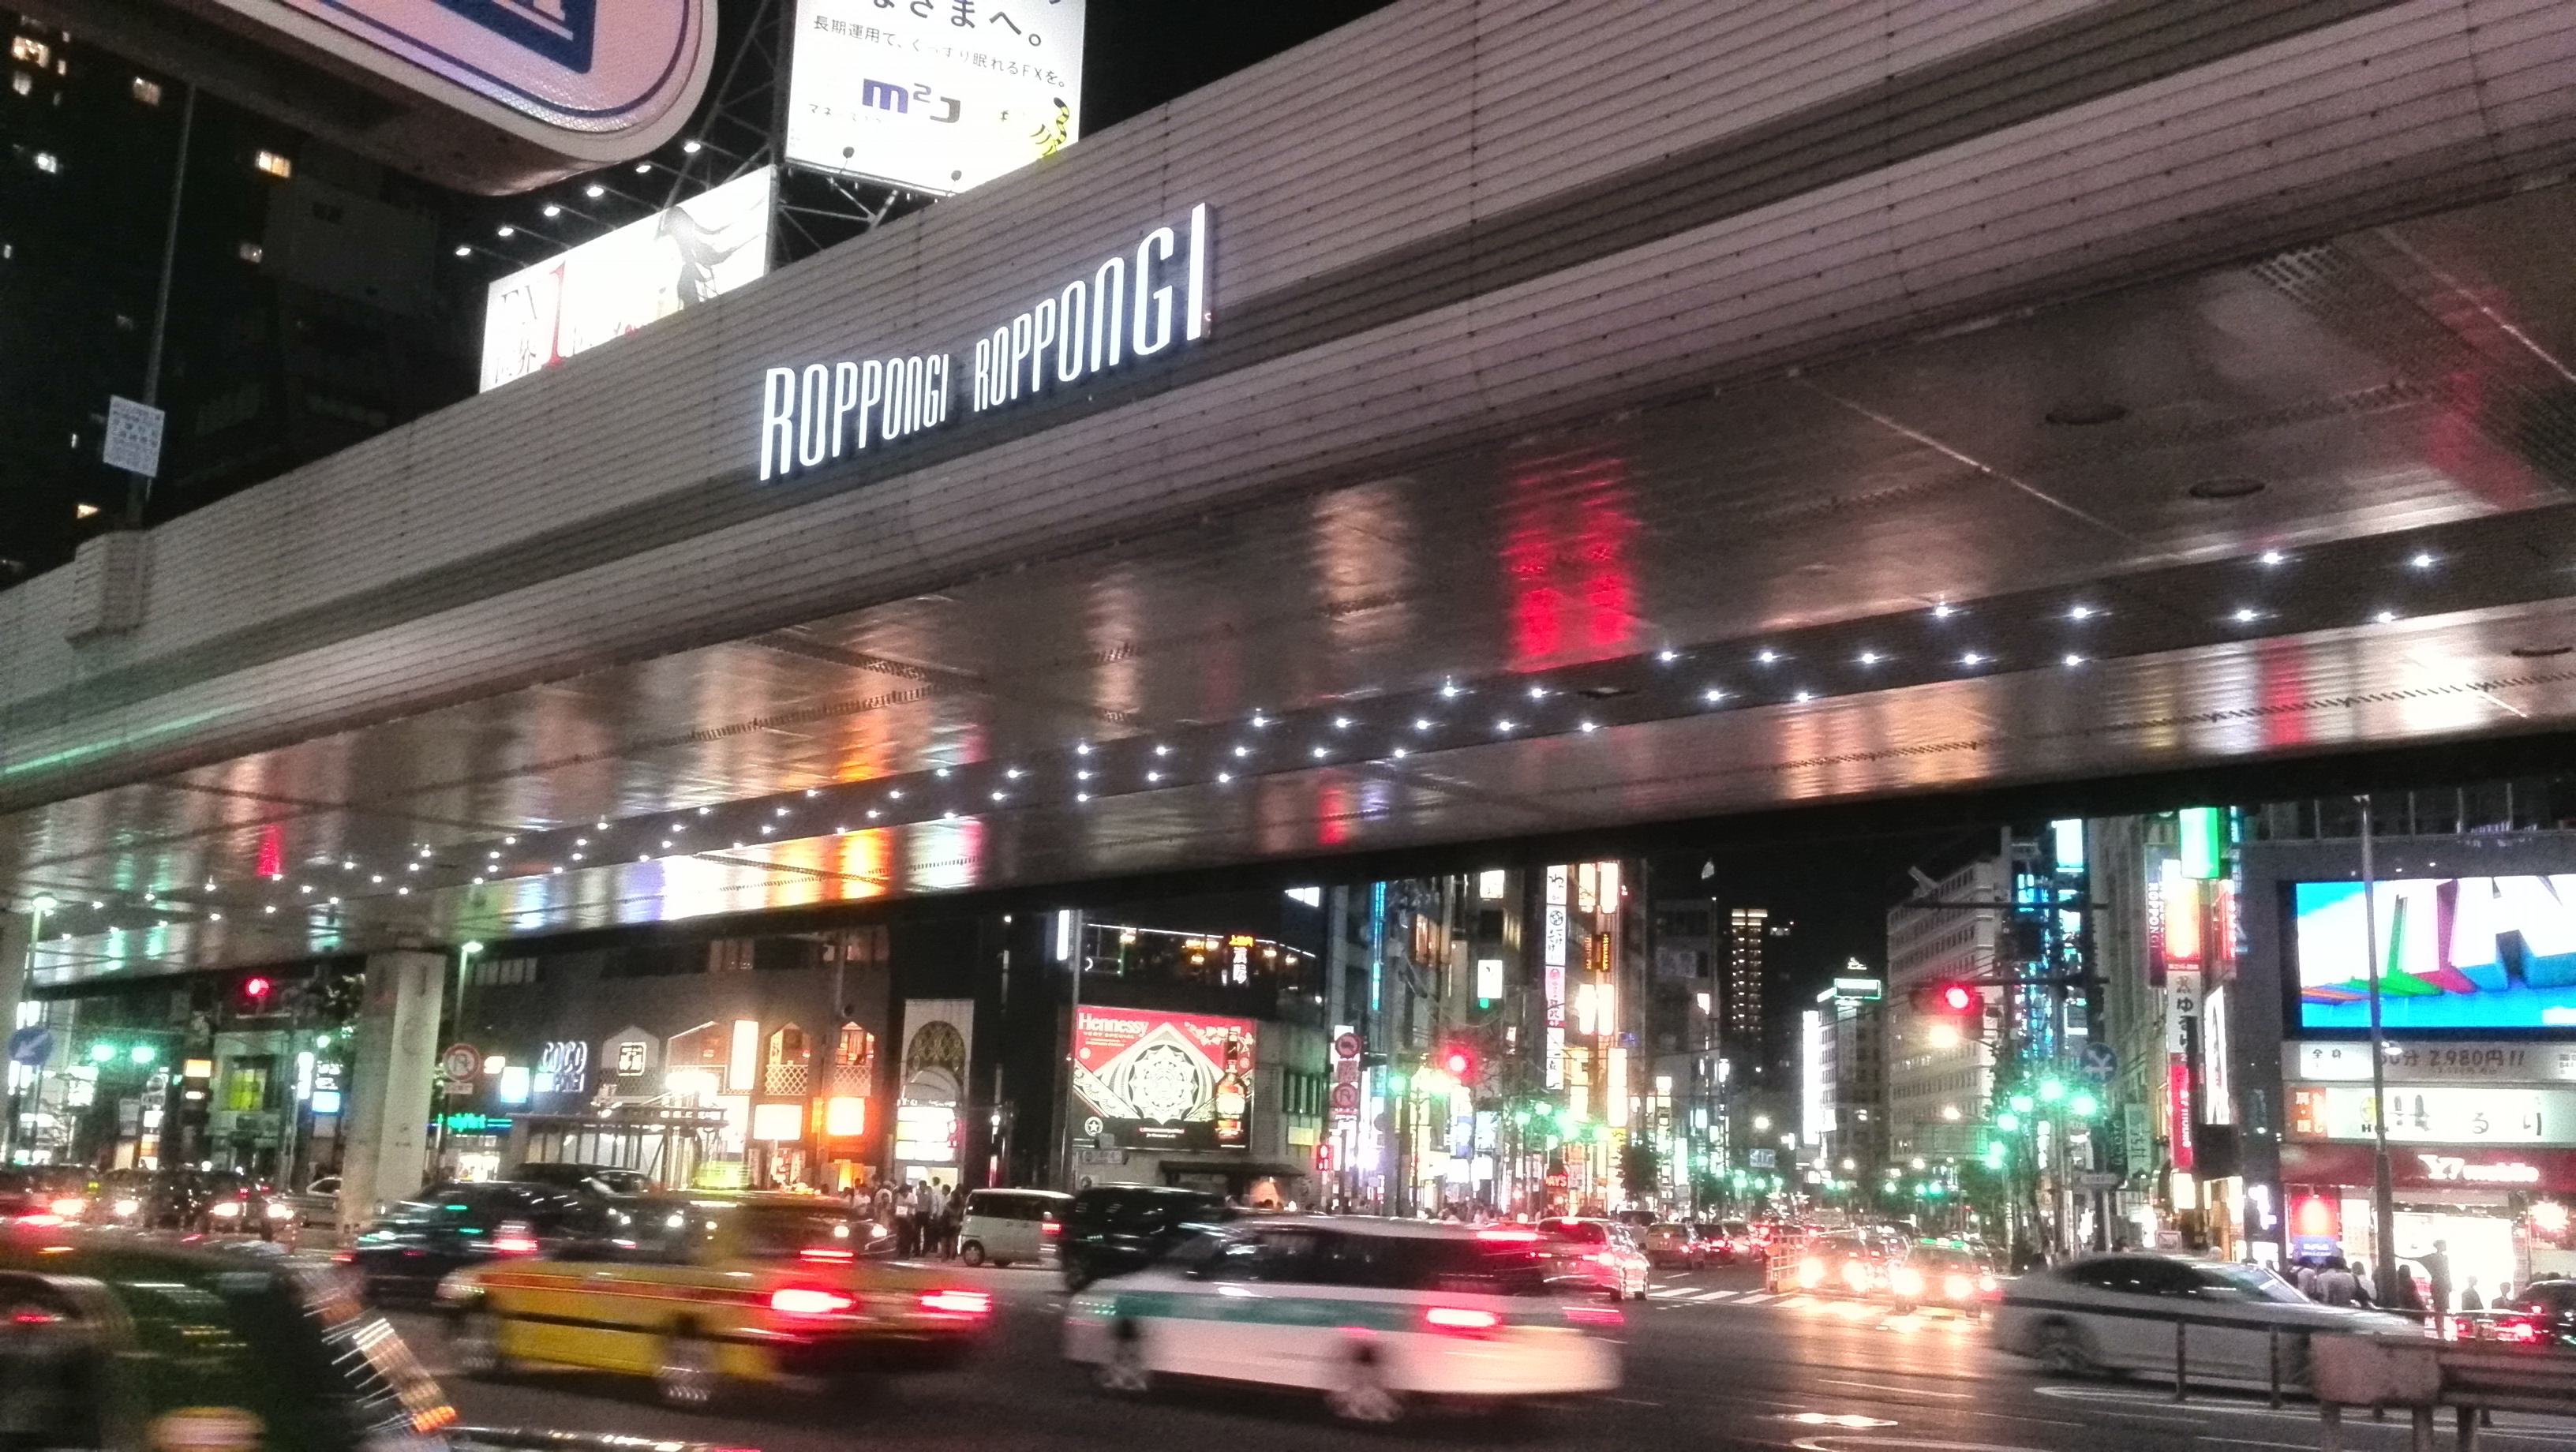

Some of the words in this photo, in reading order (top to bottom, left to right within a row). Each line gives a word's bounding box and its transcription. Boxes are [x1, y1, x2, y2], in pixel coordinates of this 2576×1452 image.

[760, 354, 949, 481] ROPPONGI
[974, 203, 1212, 412] ROPPONGI
[1078, 1012, 1149, 1037] Hennessy
